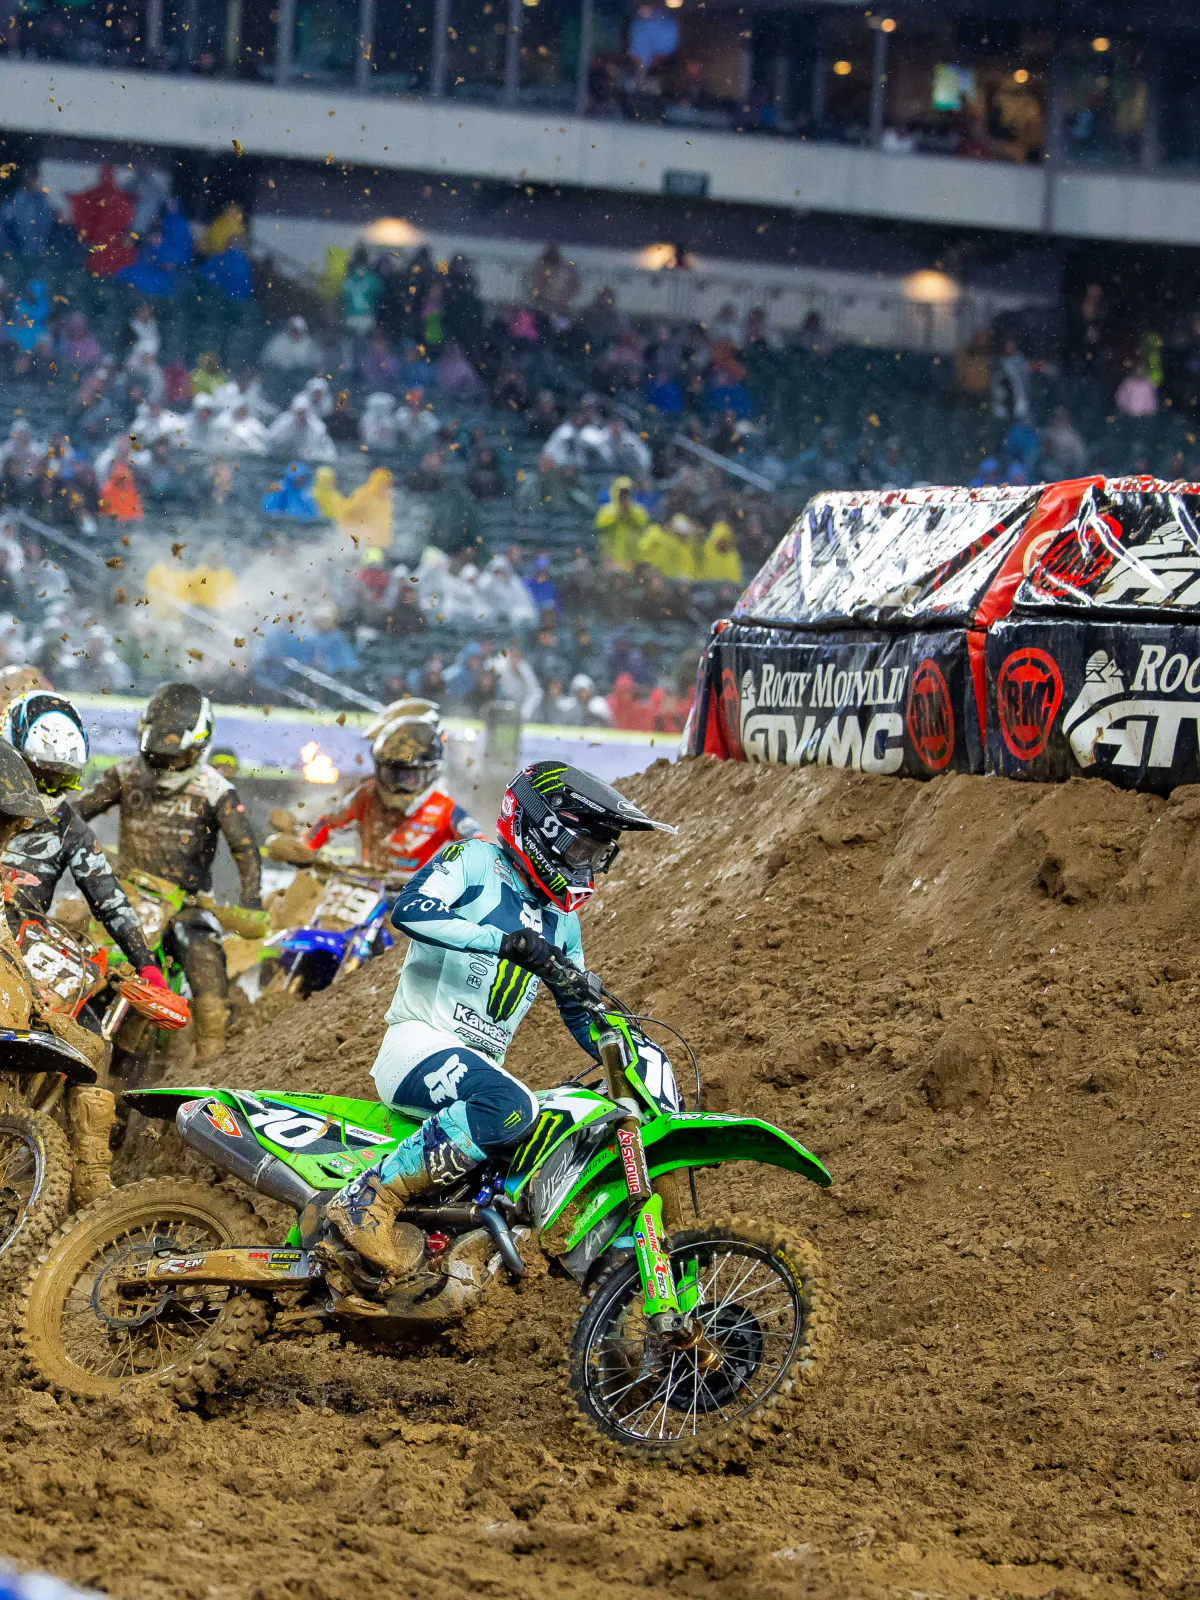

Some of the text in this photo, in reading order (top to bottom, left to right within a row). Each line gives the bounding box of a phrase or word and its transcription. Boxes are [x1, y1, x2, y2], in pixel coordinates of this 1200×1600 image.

[757, 663, 812, 707] ROCKY
[523, 835, 556, 876] MONSTER
[402, 898, 450, 913] FOX
[283, 1092, 325, 1101] Kawasaki
[621, 1146, 641, 1195] SHOWA
[644, 1213, 659, 1252] BRAKING
[272, 1252, 301, 1260] EXCEL
